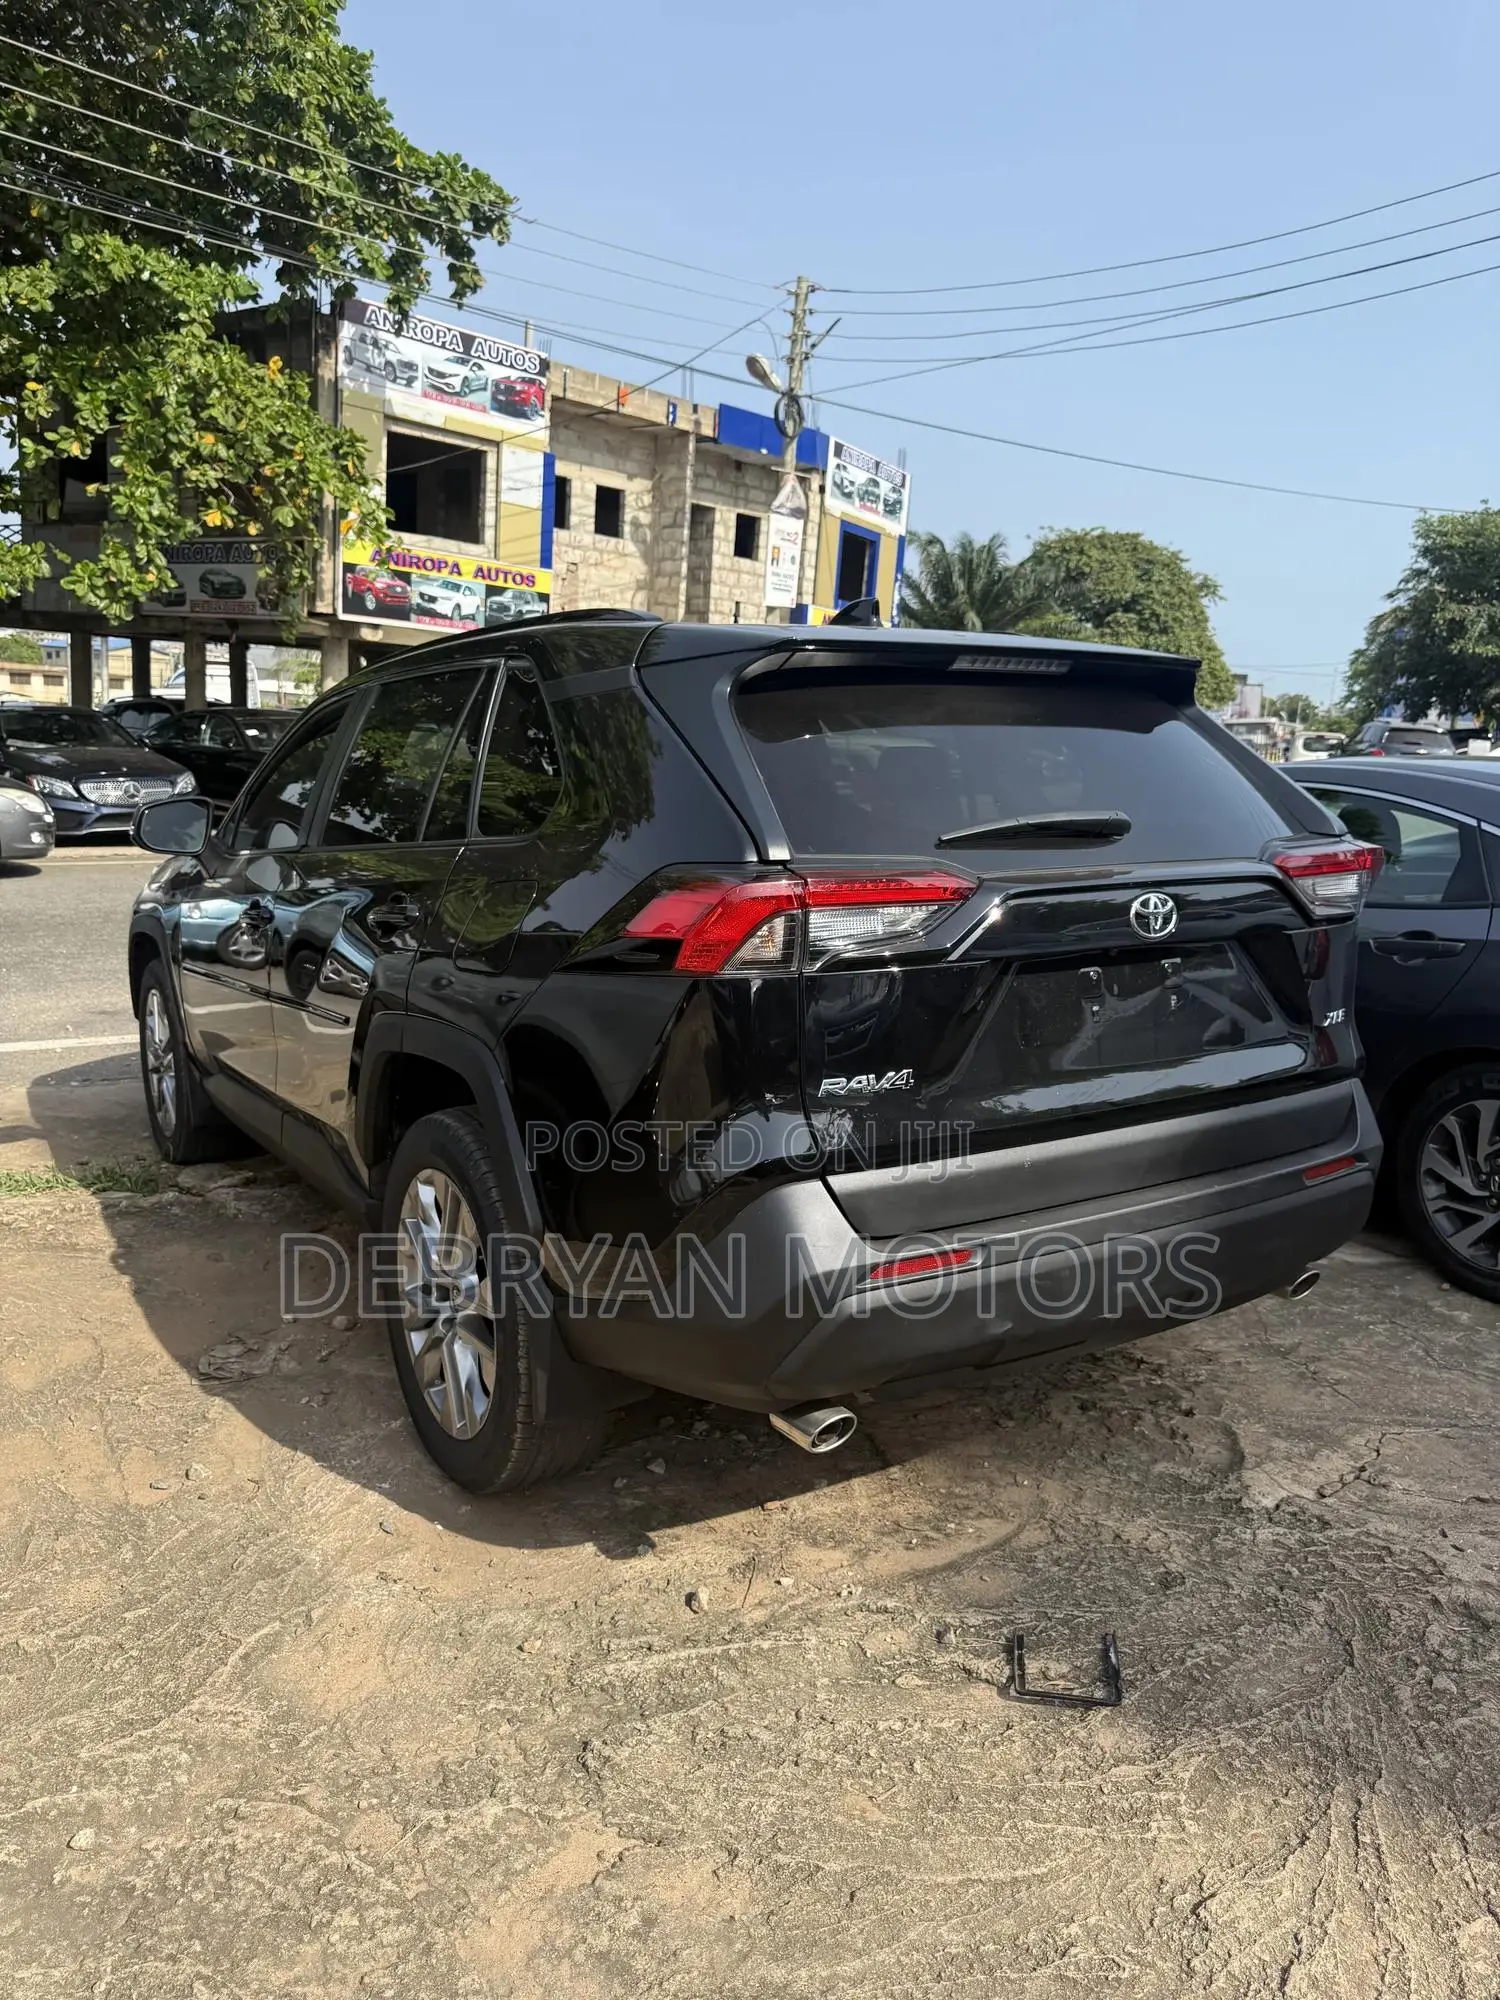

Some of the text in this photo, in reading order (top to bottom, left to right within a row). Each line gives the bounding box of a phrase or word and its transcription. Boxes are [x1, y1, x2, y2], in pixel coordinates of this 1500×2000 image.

[363, 306, 540, 374] ANROPA AUTOS
[473, 564, 536, 588] AUTOS
[818, 1069, 915, 1097] RAV4
